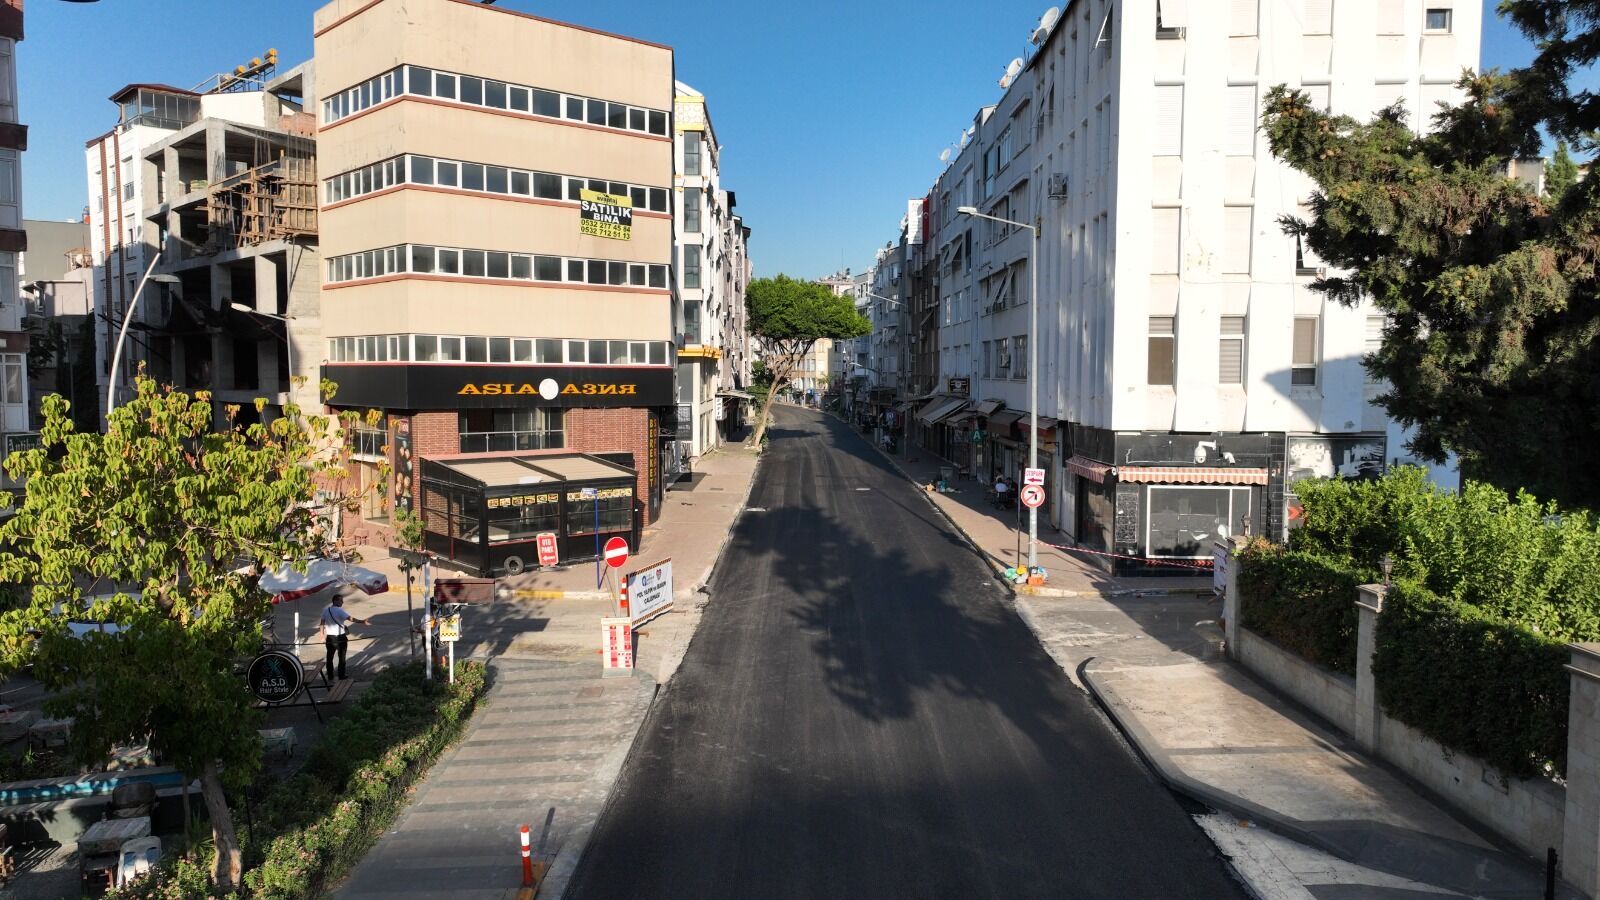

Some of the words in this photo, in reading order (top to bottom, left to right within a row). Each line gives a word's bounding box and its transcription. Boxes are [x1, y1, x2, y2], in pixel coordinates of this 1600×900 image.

[581, 200, 632, 218] SATILIK
[581, 219, 598, 228] 0532
[581, 226, 598, 234] 0532
[457, 383, 540, 395] ASIA
[560, 383, 637, 395] АЗИЯ
[262, 678, 286, 688] A.S.D
